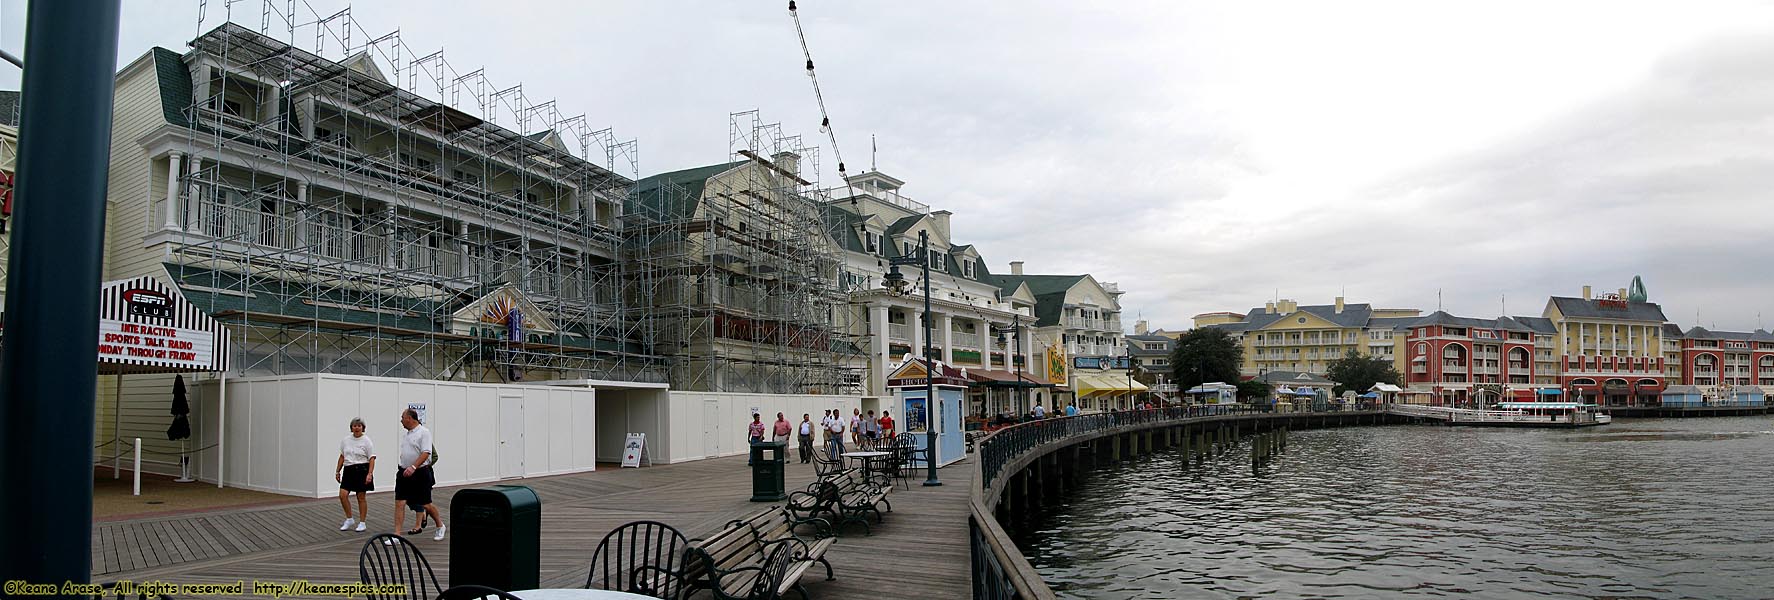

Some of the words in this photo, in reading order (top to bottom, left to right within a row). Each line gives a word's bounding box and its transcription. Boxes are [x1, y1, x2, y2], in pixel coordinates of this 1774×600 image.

[132, 293, 166, 305] ESPN
[132, 305, 169, 317] CLUB
[105, 333, 140, 345] SPORTS
[144, 337, 165, 348] TALK
[168, 339, 193, 350] RADIO
[97, 344, 124, 355] ONDAY
[127, 347, 166, 359] THROUGH
[169, 351, 197, 361] FRIDAY
